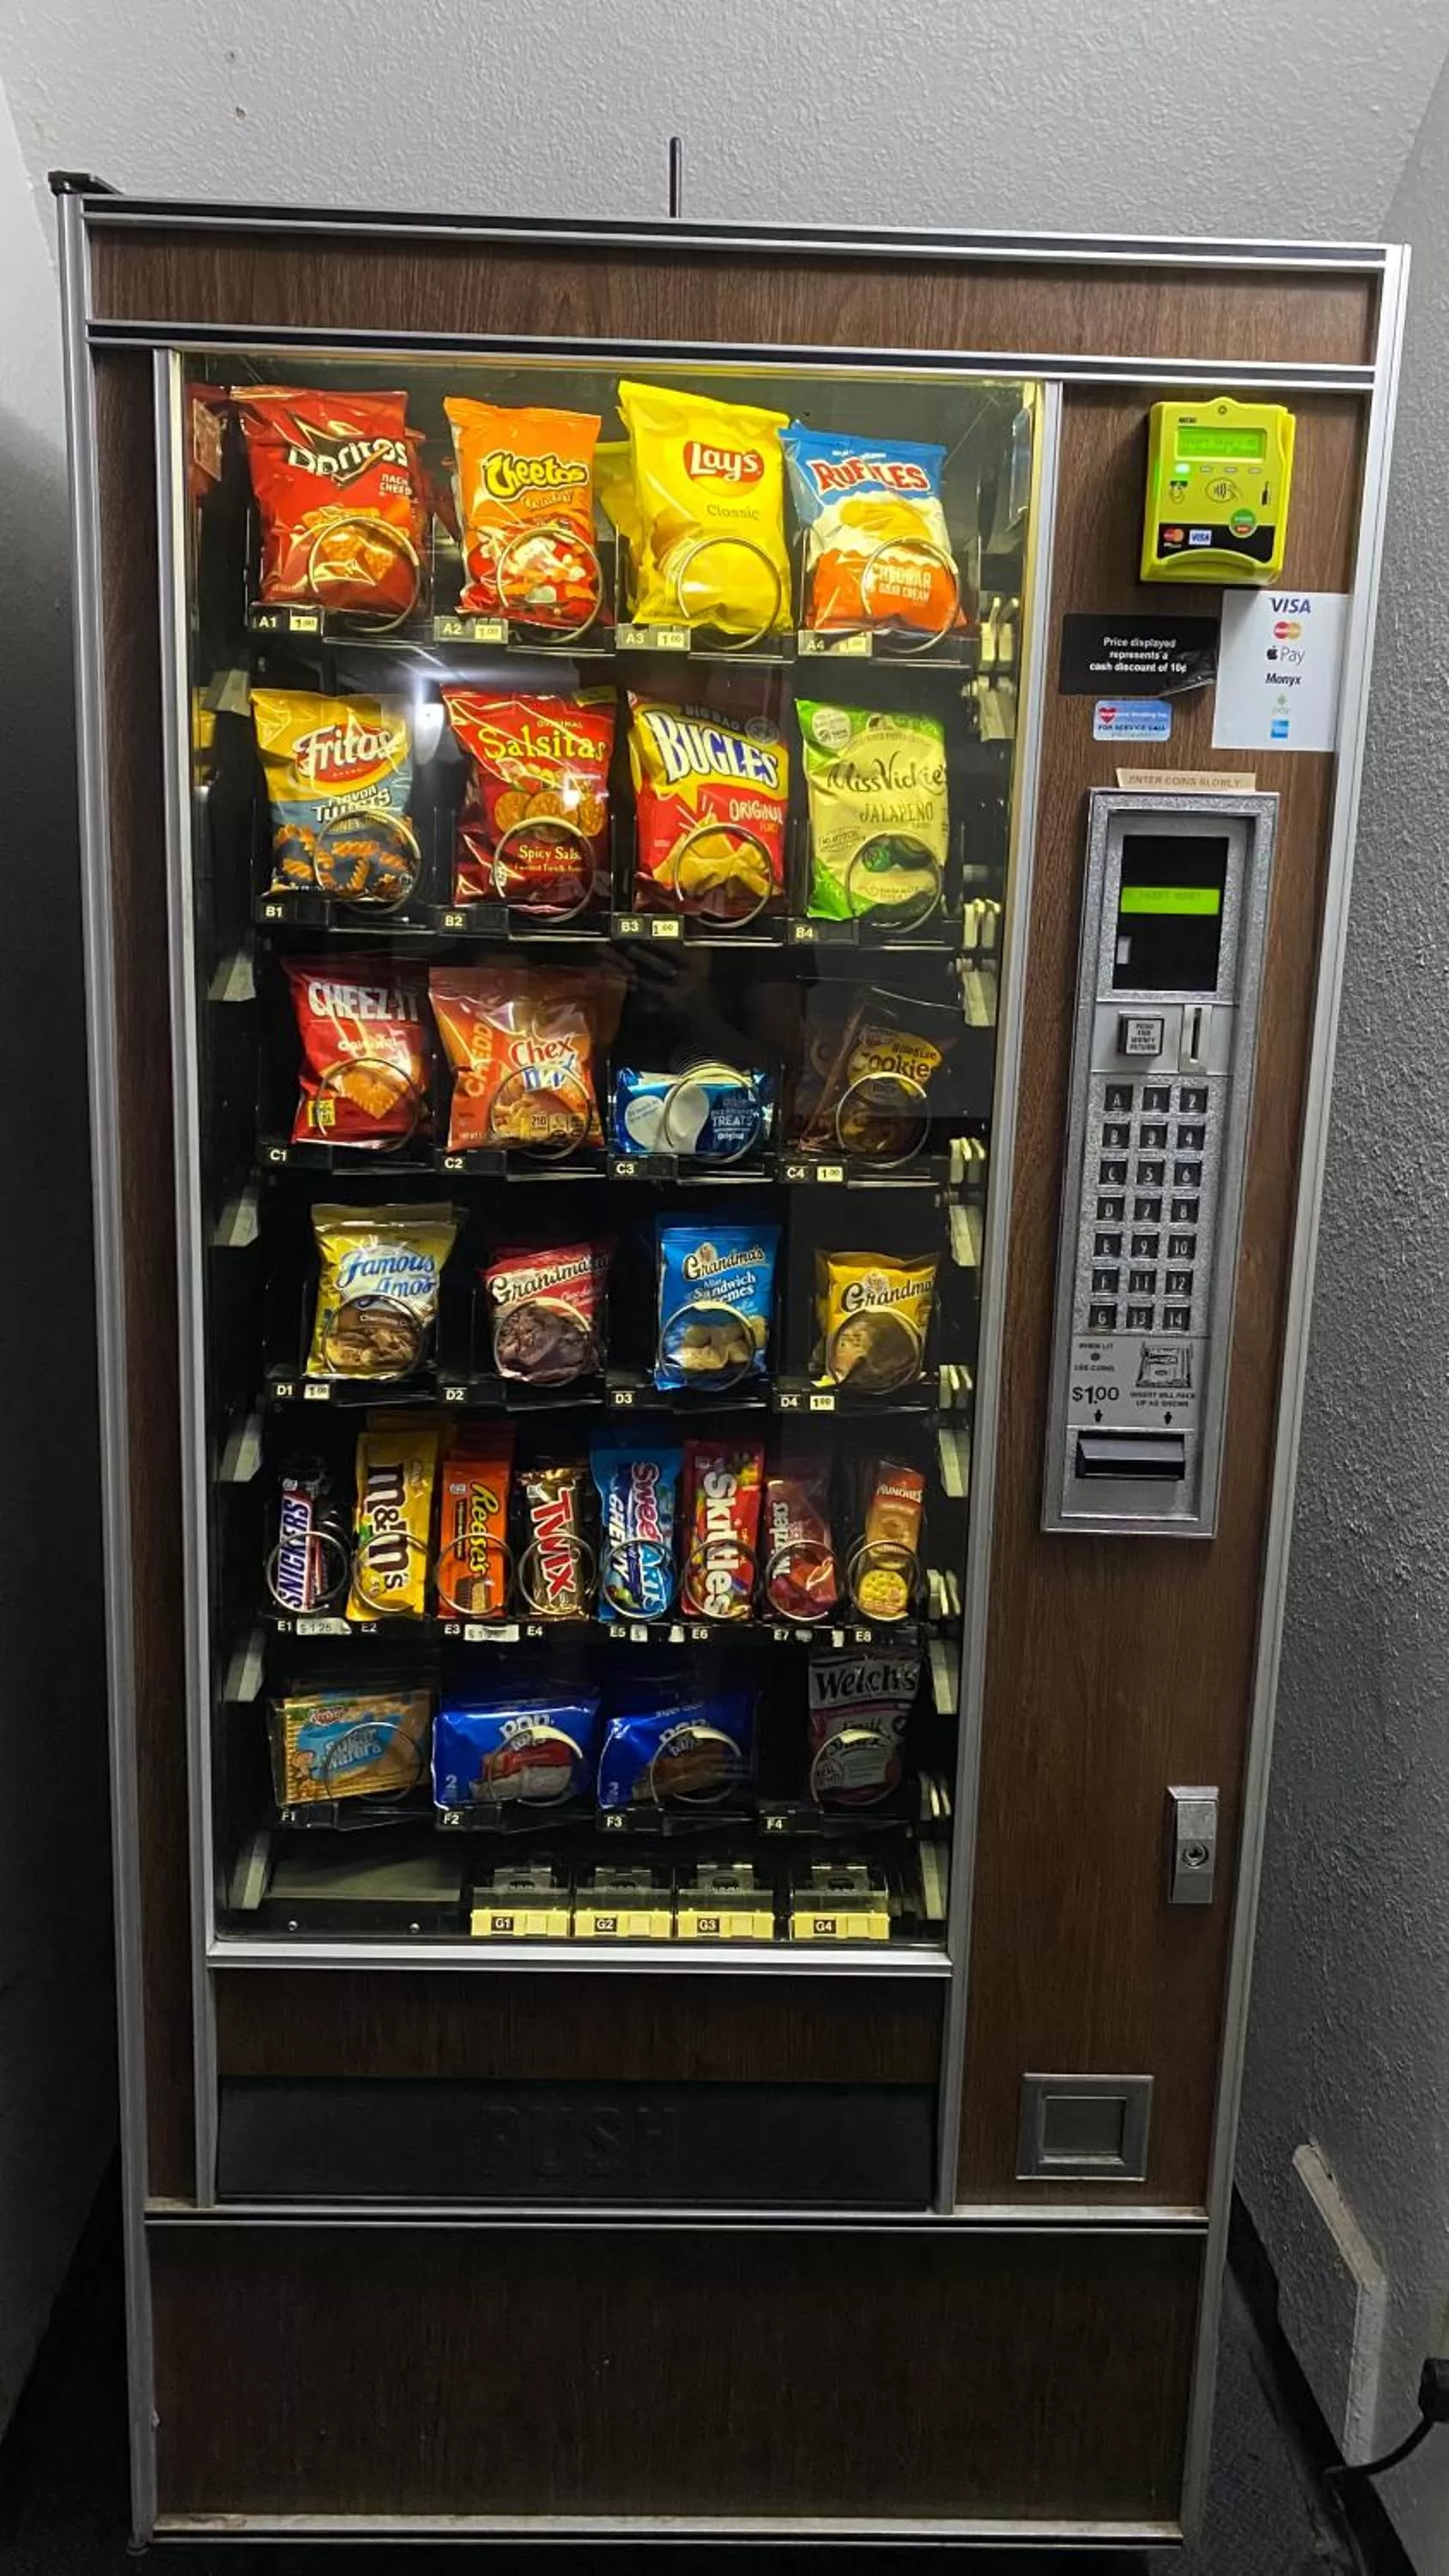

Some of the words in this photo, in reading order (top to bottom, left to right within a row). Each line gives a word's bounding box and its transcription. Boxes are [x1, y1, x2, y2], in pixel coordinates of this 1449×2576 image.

[288, 439, 409, 482] Doritos
[689, 440, 761, 483] Lay's
[482, 453, 591, 498] Cheetos
[810, 456, 931, 493] RUFFLES
[706, 503, 761, 521] Classic
[1270, 598, 1312, 614] VISA
[258, 615, 277, 629] A1
[442, 623, 463, 636] A2
[625, 634, 645, 644] A3
[806, 640, 825, 651] A4
[1103, 637, 1129, 647] Price
[1131, 638, 1177, 649] displayed
[1109, 651, 1160, 660] represents
[1162, 652, 1168, 660] a
[1281, 647, 1306, 665] Pay
[1089, 663, 1113, 671] cash
[1114, 663, 1156, 672] discount
[1159, 663, 1168, 672] of
[1265, 672, 1302, 687] Monyx
[293, 724, 393, 776] Fritos
[477, 725, 607, 762] Salsitas
[645, 712, 779, 789] BUGLES
[827, 762, 882, 793] Miss
[1128, 775, 1162, 785] ENTER
[1164, 776, 1197, 786] COINS
[1198, 778, 1242, 787] SLOWLY
[729, 798, 784, 824] ORIGINAL
[518, 845, 551, 862] Spicy
[265, 906, 282, 918] B1
[445, 915, 464, 927] B2
[621, 920, 640, 933] B3
[509, 1035, 575, 1067] Chex
[851, 1049, 931, 1078] Cookie
[1113, 1092, 1121, 1107] A
[1152, 1093, 1158, 1108] 1
[1189, 1093, 1197, 1108] 2
[712, 1115, 755, 1127] TREATS
[1148, 1131, 1156, 1145] 3
[1185, 1131, 1193, 1145] 4
[270, 1149, 287, 1161] C1
[444, 1159, 463, 1170] C2
[615, 1163, 634, 1174] C3
[786, 1167, 805, 1179] C4
[1108, 1168, 1116, 1181] C
[1145, 1167, 1154, 1182] 5
[1182, 1168, 1191, 1182] 6
[1105, 1203, 1113, 1217] D
[1143, 1204, 1151, 1218] 7
[1179, 1205, 1187, 1218] 8
[1103, 1240, 1110, 1253] E
[1140, 1240, 1148, 1254] 9
[1174, 1240, 1188, 1255] 10
[684, 1245, 766, 1280] Grandma's
[336, 1253, 436, 1288] Famous
[693, 1270, 756, 1301] Sandwich
[1100, 1275, 1106, 1289] F
[1135, 1275, 1149, 1289] 11
[1171, 1277, 1185, 1291] 12
[1098, 1310, 1106, 1324] G
[1132, 1311, 1147, 1325] 13
[1169, 1312, 1182, 1326] 14
[277, 1384, 294, 1396] D1
[446, 1390, 464, 1401] D2
[1072, 1385, 1120, 1405] $1.00
[615, 1394, 633, 1404] D3
[780, 1397, 798, 1407] D4
[876, 1484, 924, 1504] MUNCHIES
[470, 1481, 500, 1577] Reese's
[609, 1493, 630, 1583] CHEWY
[703, 1471, 740, 1614] Skittles
[278, 1499, 309, 1609] SNICKERS
[277, 1621, 292, 1631] E1
[361, 1621, 377, 1632] E2
[444, 1625, 461, 1635] E3
[526, 1625, 543, 1637] E4
[610, 1627, 626, 1637] E5
[692, 1629, 708, 1639] E6
[773, 1631, 789, 1641] E7
[855, 1631, 871, 1643] E8
[815, 1664, 917, 1700] Welch's
[446, 1774, 458, 1789] 2
[281, 1811, 296, 1821] F1
[443, 1814, 460, 1825] F2
[607, 1816, 622, 1827] F3
[767, 1819, 783, 1830] F4
[494, 1917, 511, 1929] G1
[597, 1918, 615, 1929] G2
[697, 1918, 716, 1930] G3
[815, 1920, 833, 1931] G4
